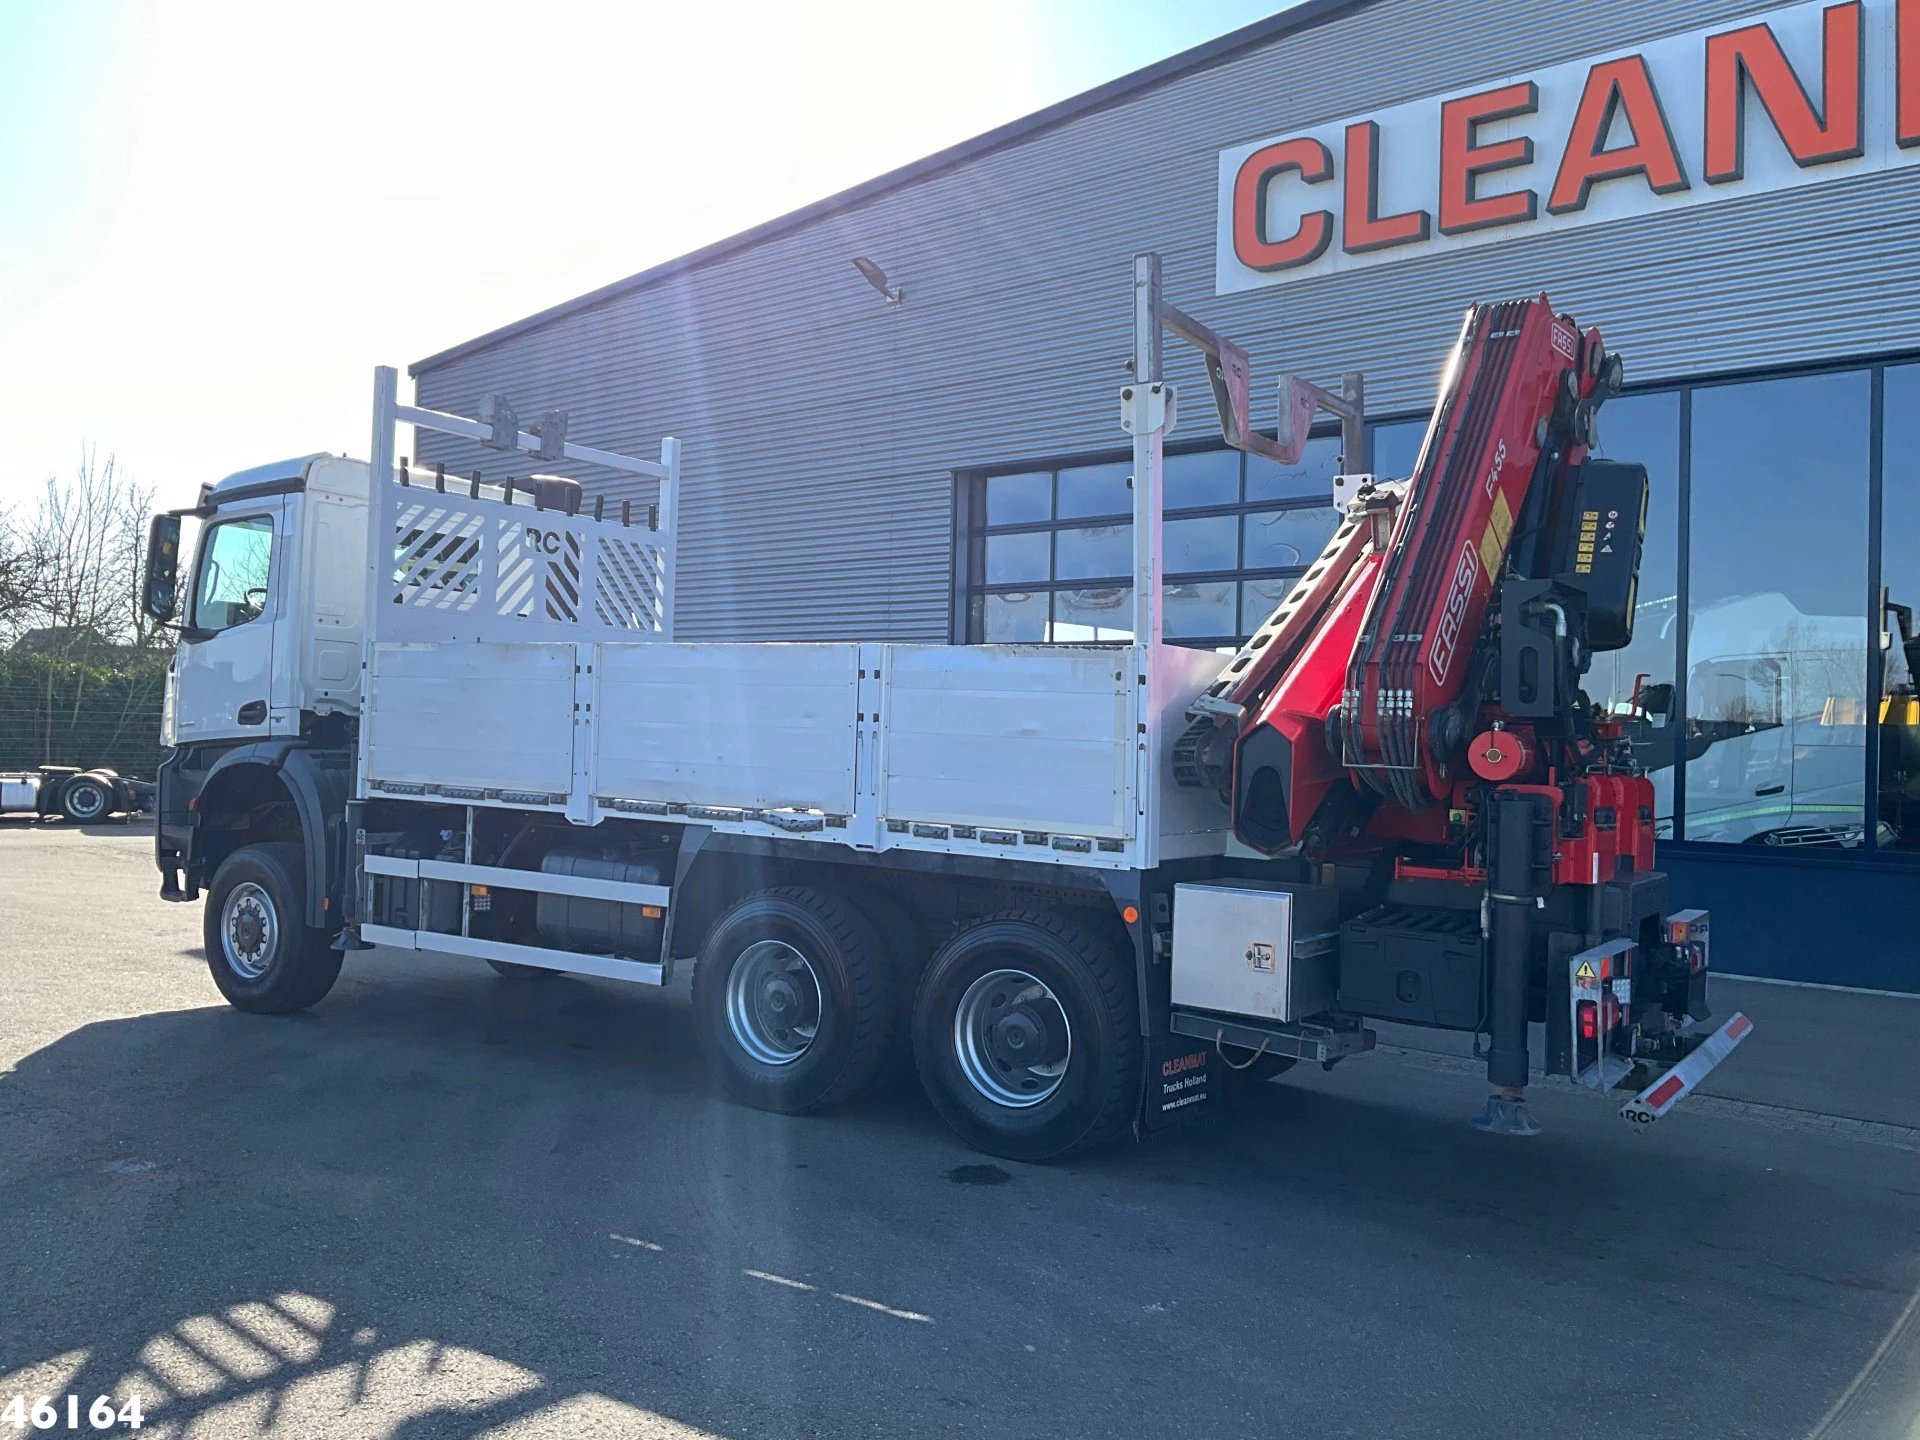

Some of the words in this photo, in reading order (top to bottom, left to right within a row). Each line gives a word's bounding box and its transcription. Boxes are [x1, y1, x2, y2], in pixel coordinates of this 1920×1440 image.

[1232, 0, 1920, 272] CLEAN
[1553, 327, 1574, 356] FASSI
[1485, 438, 1507, 500] F455
[526, 527, 561, 554] RC
[1432, 550, 1476, 675] FASSI
[1162, 1051, 1207, 1077] CLEANMAT
[1163, 1081, 1183, 1094] Trucks
[1184, 1073, 1206, 1088] Holland
[1162, 1093, 1207, 1111] www.cleanmat.eu
[1626, 1109, 1650, 1123] RC
